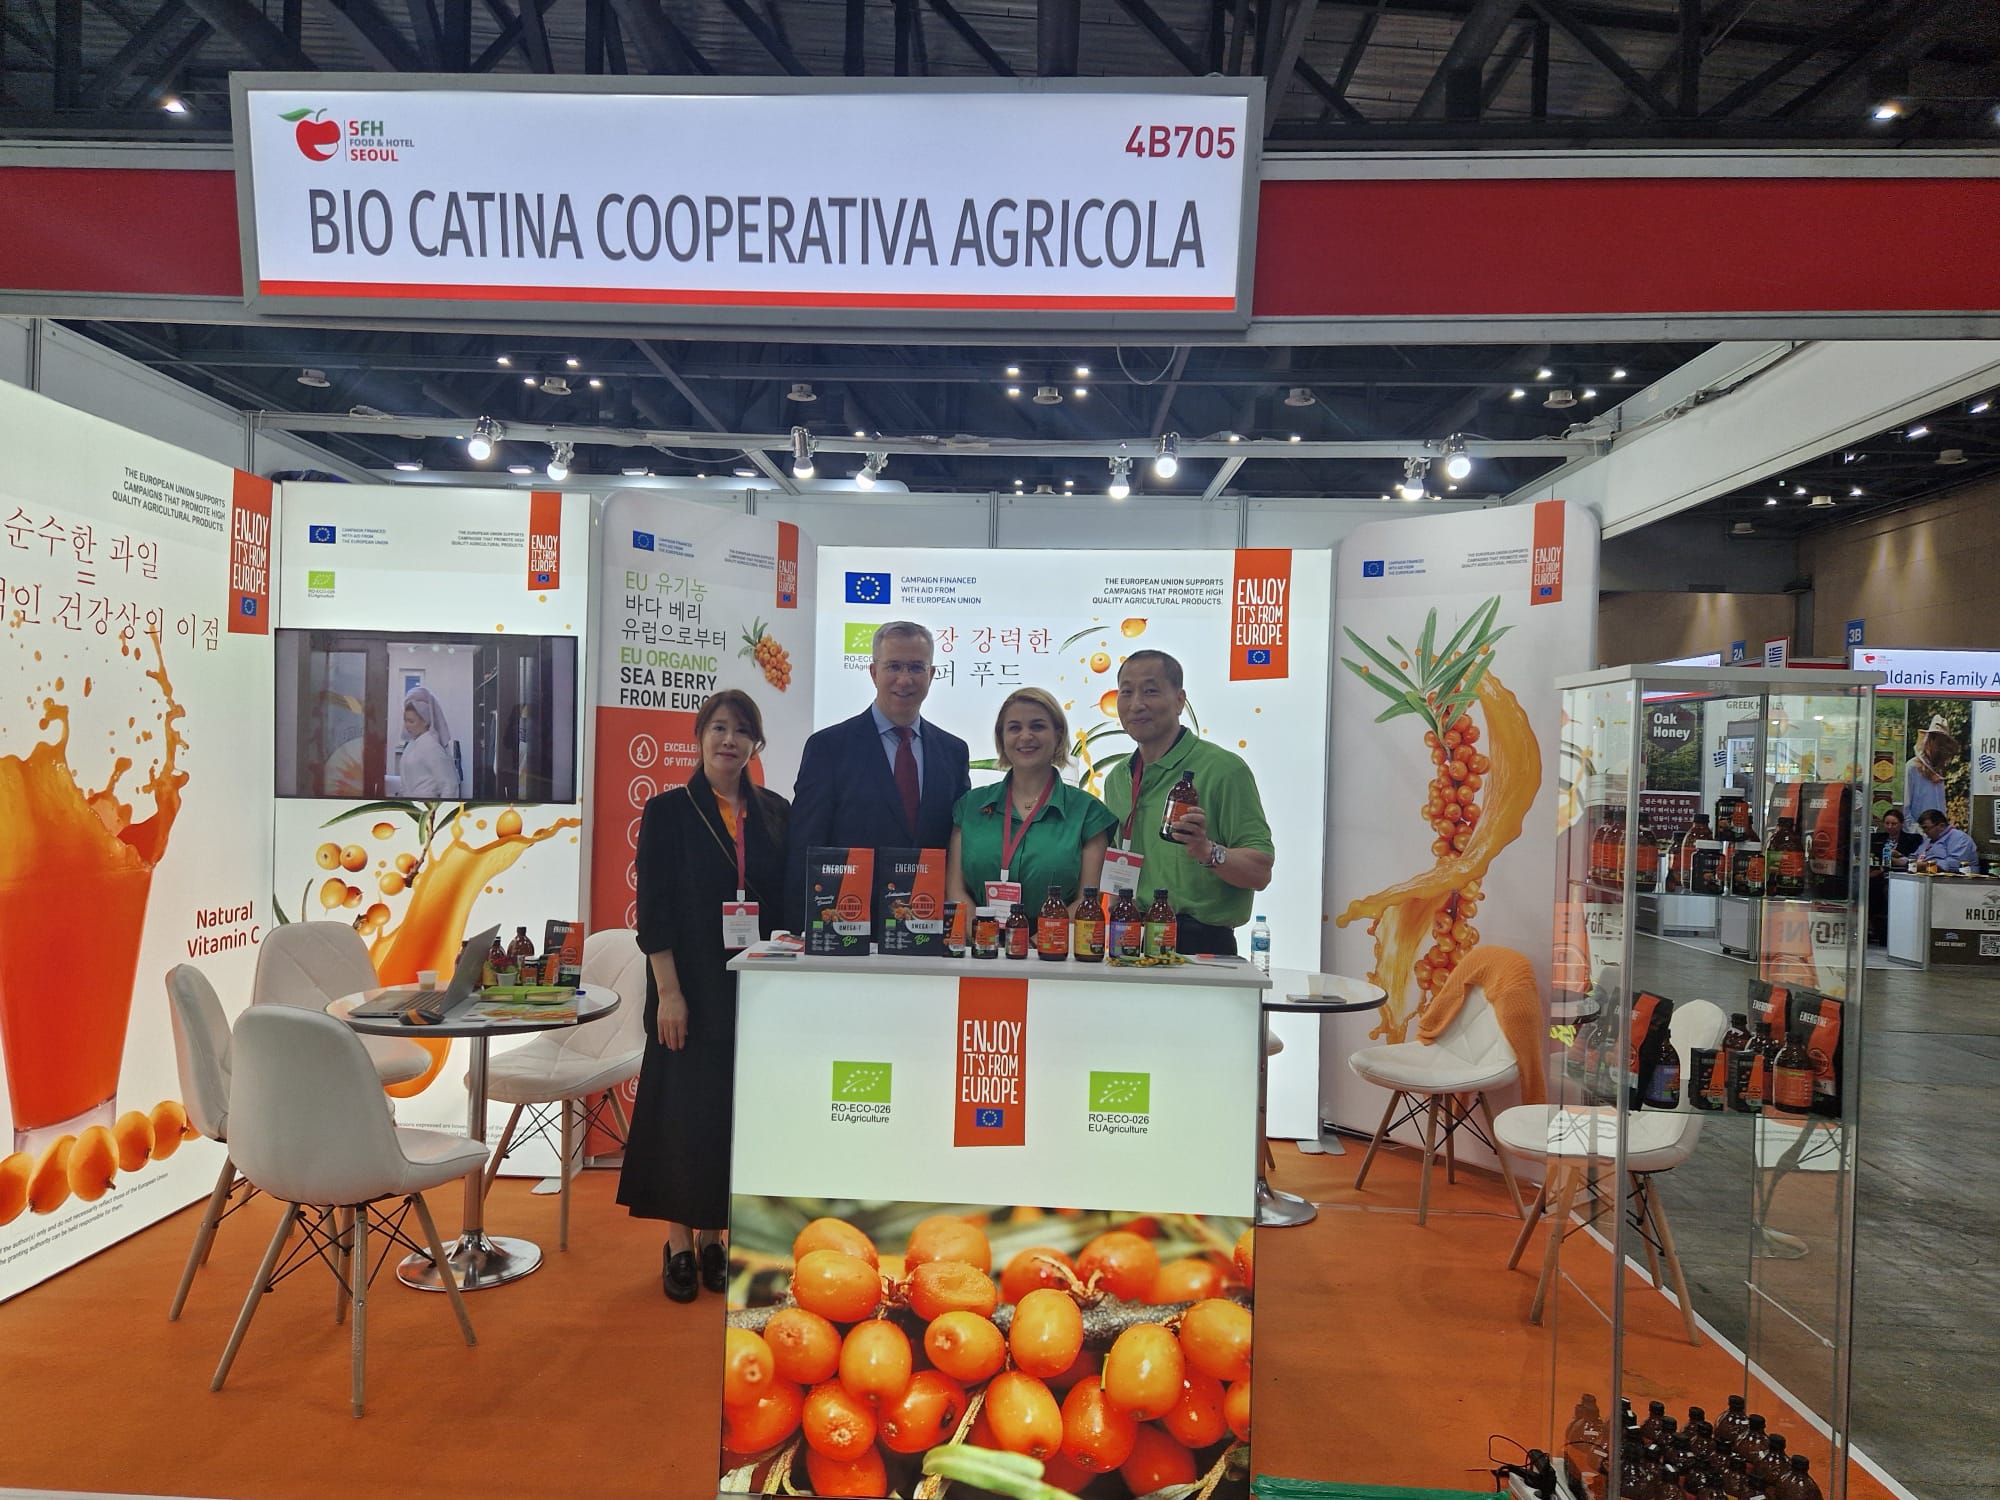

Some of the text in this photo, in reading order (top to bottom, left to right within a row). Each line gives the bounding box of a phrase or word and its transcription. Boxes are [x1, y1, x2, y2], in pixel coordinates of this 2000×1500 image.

[349, 120, 384, 136] SFH
[350, 139, 415, 147] FOOD & HOTEL
[1125, 124, 1236, 160] 4B705
[350, 149, 399, 162] SEOUL
[308, 188, 1206, 269] BIO CATINA COOPERATIVA AGRICOLA
[125, 466, 226, 508] THE EUROPEAN UNION SUPPORTS
[123, 481, 226, 521] CAMPAIGNS THAT PROMOTE HIGH
[112, 490, 224, 532] QUALITY AGRICULTURAL PRODUCTS.
[234, 507, 270, 547] ENJOY
[4, 506, 159, 580] 순수한 과일
[531, 535, 559, 550] ENJOY
[234, 541, 267, 569] IT'S FROM
[532, 550, 557, 560] IT'S FROM
[1535, 546, 1562, 564] ENJOY
[531, 560, 557, 572] EUROPE
[779, 560, 796, 574] ENJOY
[1535, 562, 1560, 574] IT'S FROM
[233, 563, 266, 596] EUROPE
[626, 570, 708, 603] EU 유기농
[901, 576, 977, 584] CAMPAIGN FINANCED
[1185, 578, 1224, 586] SUPPORTS
[1534, 572, 1560, 586] EUROPE
[778, 582, 796, 594] EUROPE
[901, 586, 919, 594] WITH
[921, 586, 933, 594] AID
[1205, 588, 1224, 596] HIGH
[1237, 578, 1287, 606] ENJOY
[901, 596, 982, 605] THE EUROPEAN UNION
[1124, 597, 1180, 605] AGRICULTURAL
[626, 594, 701, 625] 바다 베리
[1237, 605, 1283, 624] IT'S FROM
[56, 592, 164, 644] 건강상의
[176, 613, 220, 652] 이점
[621, 618, 726, 652] 유럽으로부터
[970, 627, 1053, 655] 강력한
[1236, 624, 1283, 646] EUROPE
[1849, 629, 1862, 643] 3B
[621, 646, 718, 673] EU ORGANIC
[1733, 648, 1743, 661] 2A
[620, 666, 718, 691] SEA BERRY
[970, 661, 1023, 688] 푸드
[1940, 671, 1987, 689] Family
[620, 687, 666, 708] FROM
[1727, 701, 1754, 710] GREEK
[1653, 712, 1678, 725] Oak
[1653, 726, 1691, 741] Honey
[664, 757, 675, 766] OF
[822, 864, 857, 874] ENERGYNE
[895, 863, 929, 874] ENERGYNE
[196, 900, 253, 930] Natural
[187, 925, 260, 958] Vitamin C
[842, 936, 858, 947] Bio
[914, 935, 930, 945] Bio
[962, 1020, 1022, 1054] ENJOY
[963, 1054, 1019, 1077] IT'S FROM
[962, 1076, 1019, 1105] EUROPE
[831, 1103, 892, 1114] RO-ECO-026
[1088, 1114, 1150, 1125] RO-ECO-026
